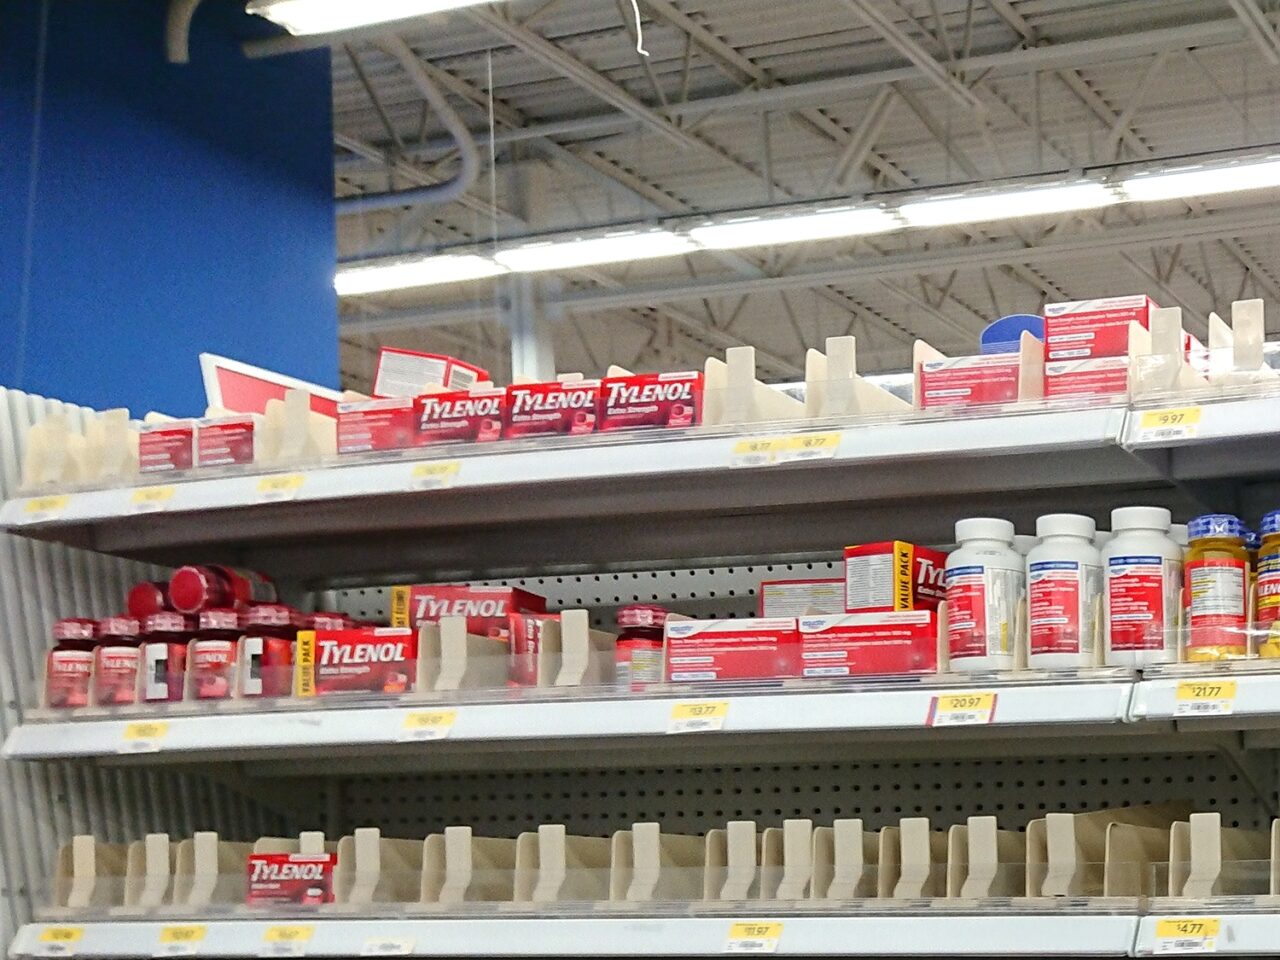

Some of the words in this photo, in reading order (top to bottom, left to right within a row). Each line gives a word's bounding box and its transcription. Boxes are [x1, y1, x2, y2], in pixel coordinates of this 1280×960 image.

[511, 389, 595, 414] TYLENOL
[606, 382, 693, 407] TYLENOL
[420, 397, 500, 422] TYLENOL
[901, 550, 910, 580] PACK
[415, 595, 507, 618] TYLENOL
[900, 581, 910, 610] VALUE
[302, 640, 312, 663] PACK
[319, 640, 408, 665] TYLENOL
[250, 859, 324, 881] TYLENOL
